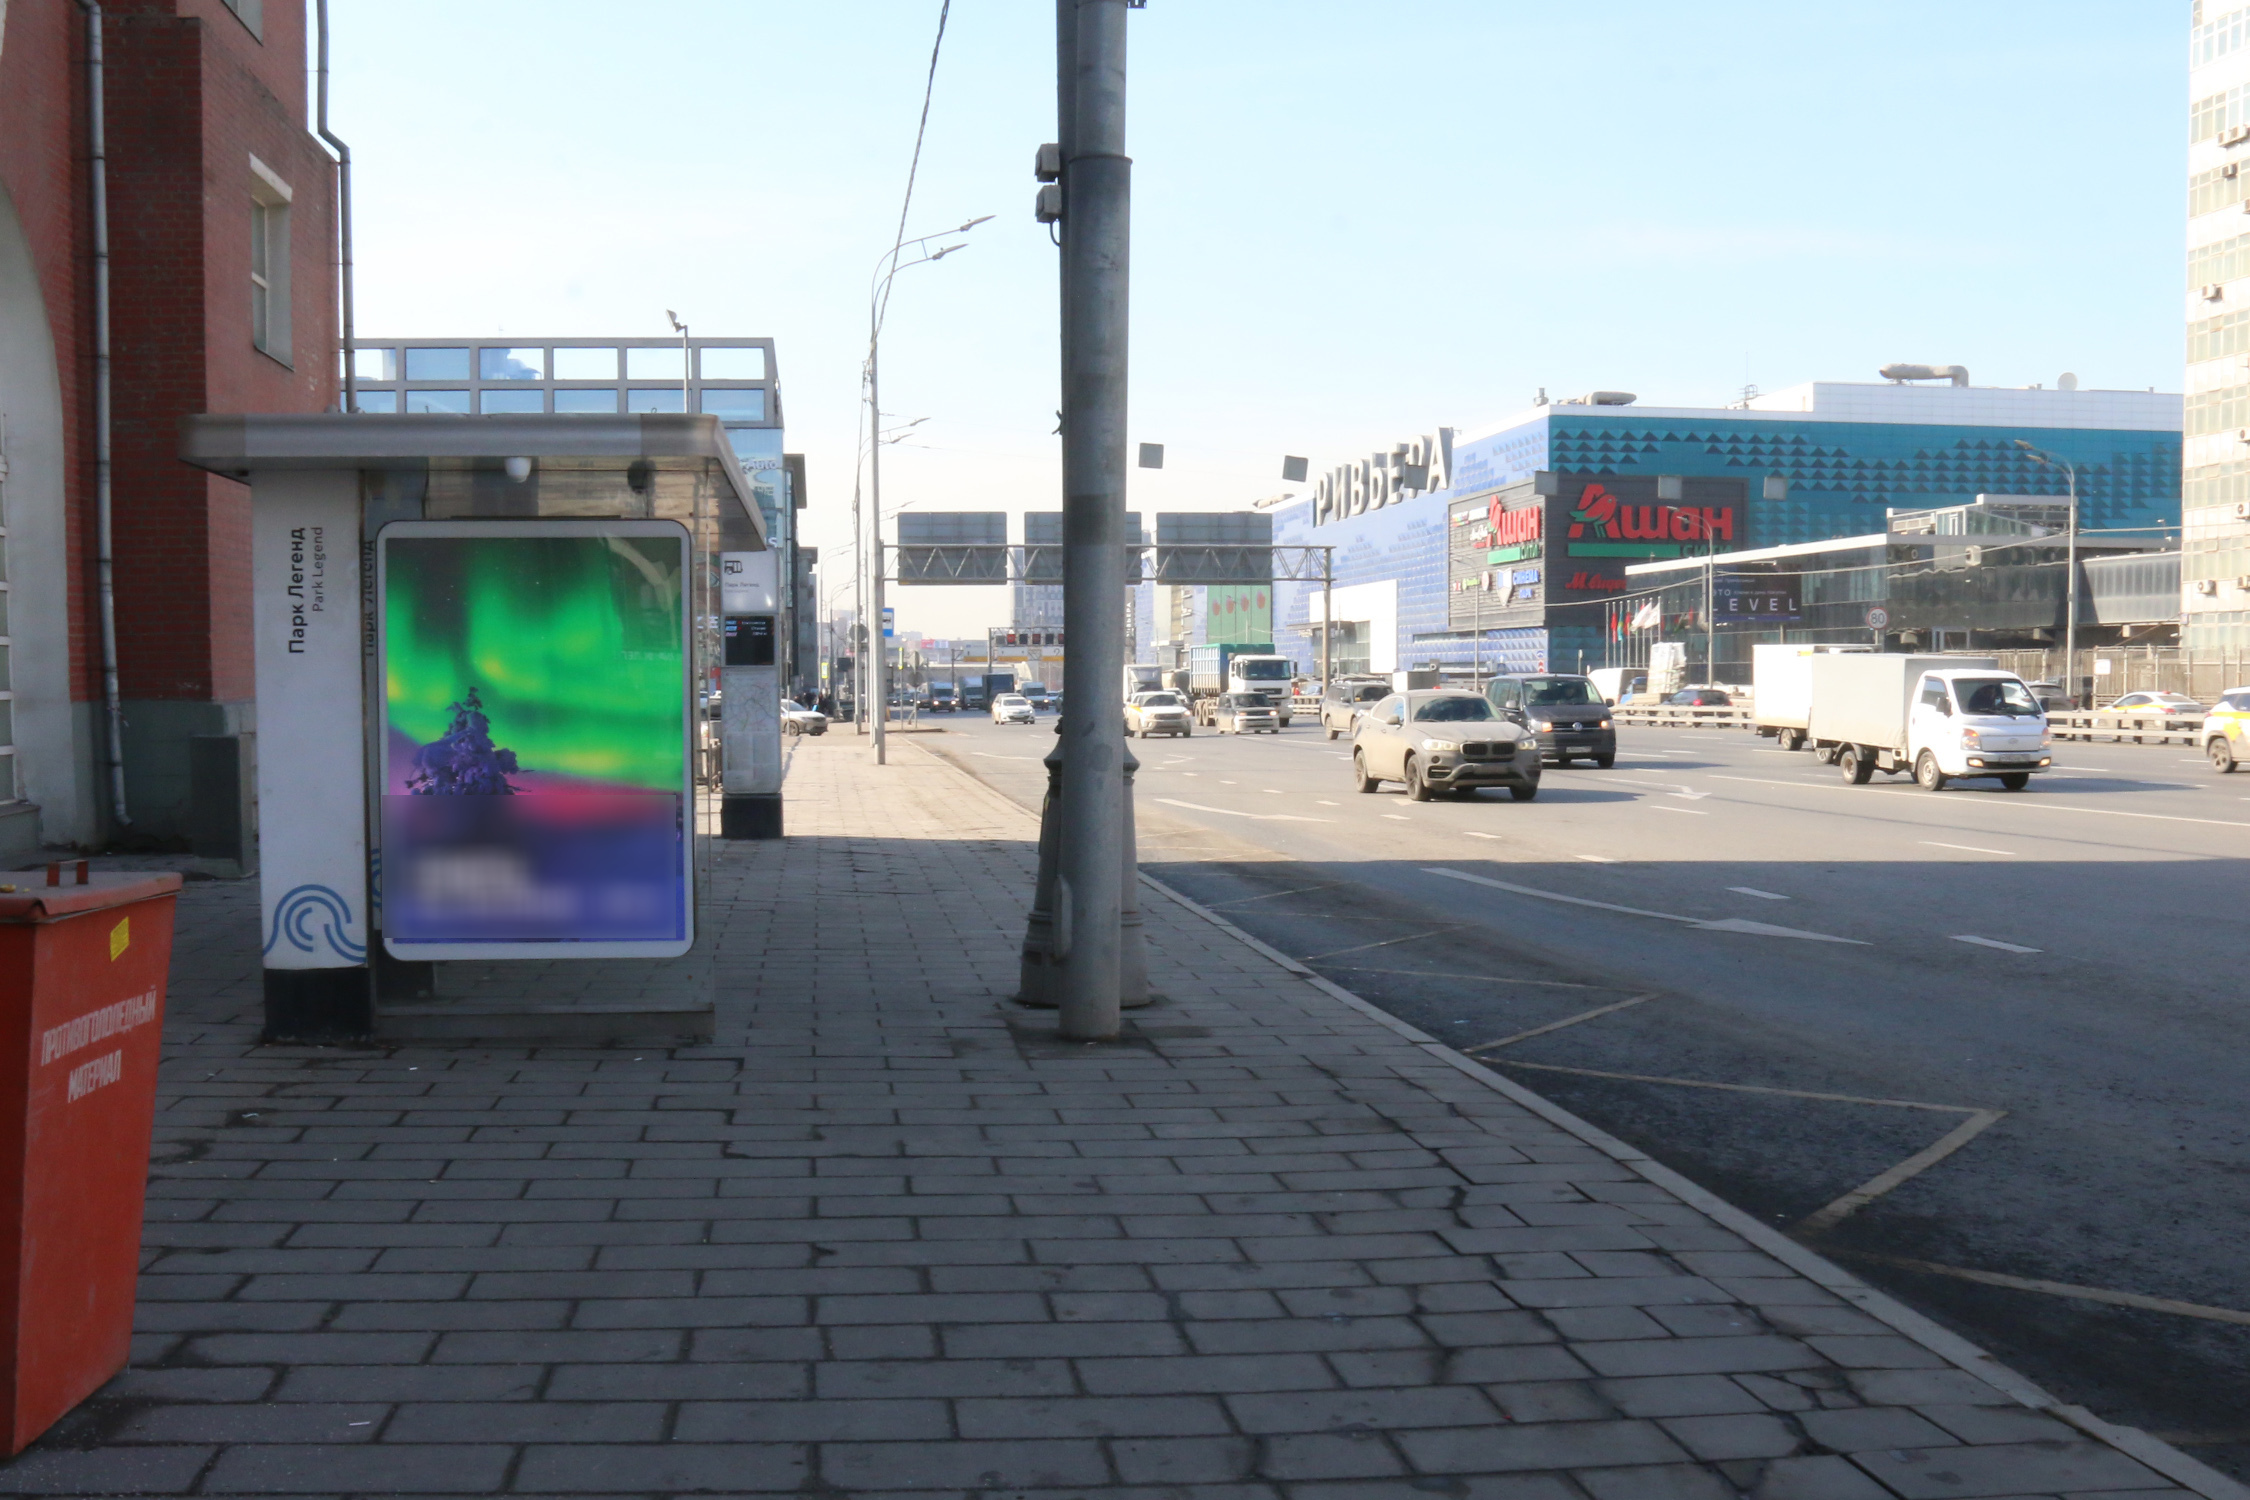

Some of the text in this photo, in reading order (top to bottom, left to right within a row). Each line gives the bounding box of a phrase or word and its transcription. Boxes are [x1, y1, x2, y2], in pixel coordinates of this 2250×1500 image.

[1316, 427, 1452, 527] РИВЬЕРА
[288, 527, 308, 653] Парк Легенд
[311, 526, 326, 612] Park Legend
[1871, 612, 1885, 624] 80
[68, 1049, 122, 1103] МАТЕРИАЛ
